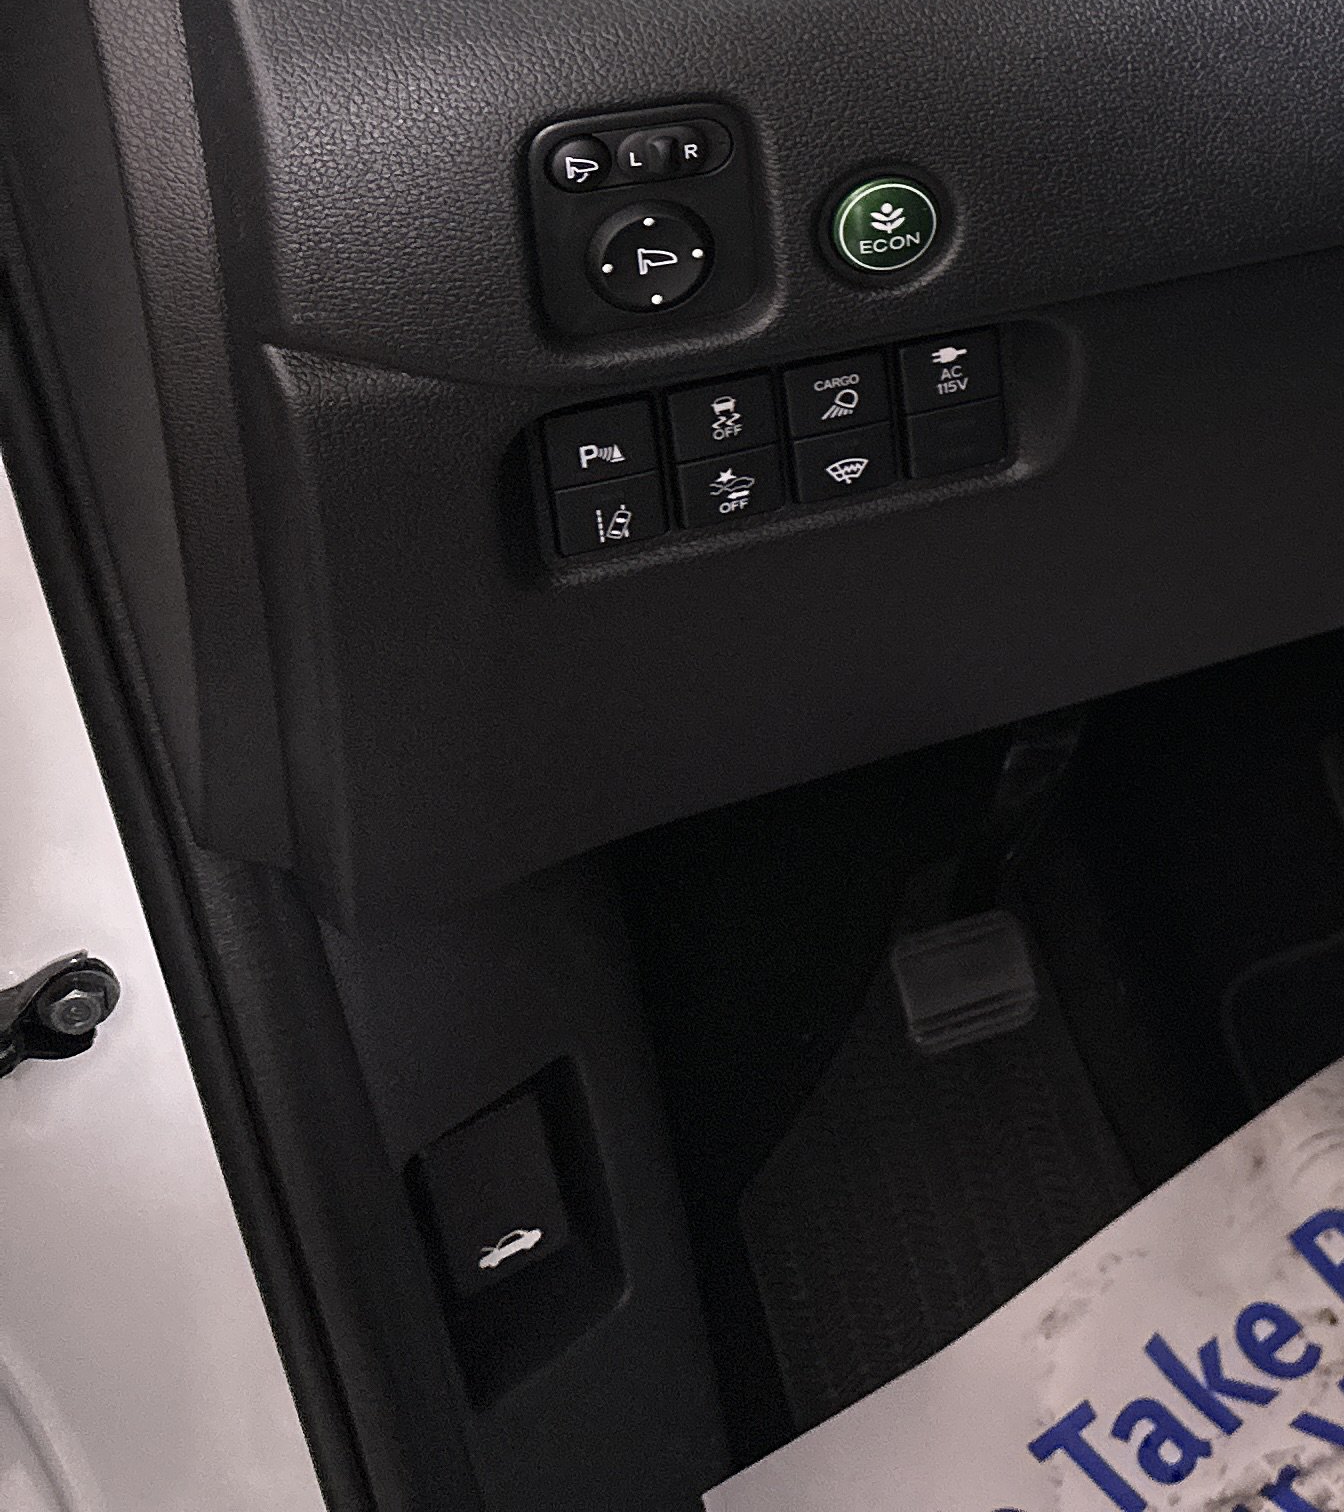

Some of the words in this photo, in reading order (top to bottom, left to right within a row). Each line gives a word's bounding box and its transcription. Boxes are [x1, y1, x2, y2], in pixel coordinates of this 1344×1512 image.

[628, 151, 643, 168] L
[683, 143, 699, 160] R
[858, 231, 922, 256] ECON
[940, 365, 963, 380] AC
[813, 372, 861, 393] CARGO
[936, 377, 969, 396] 115V
[712, 423, 743, 441] OFF
[718, 497, 750, 514] OFF
[1028, 1300, 1323, 1512] Take
